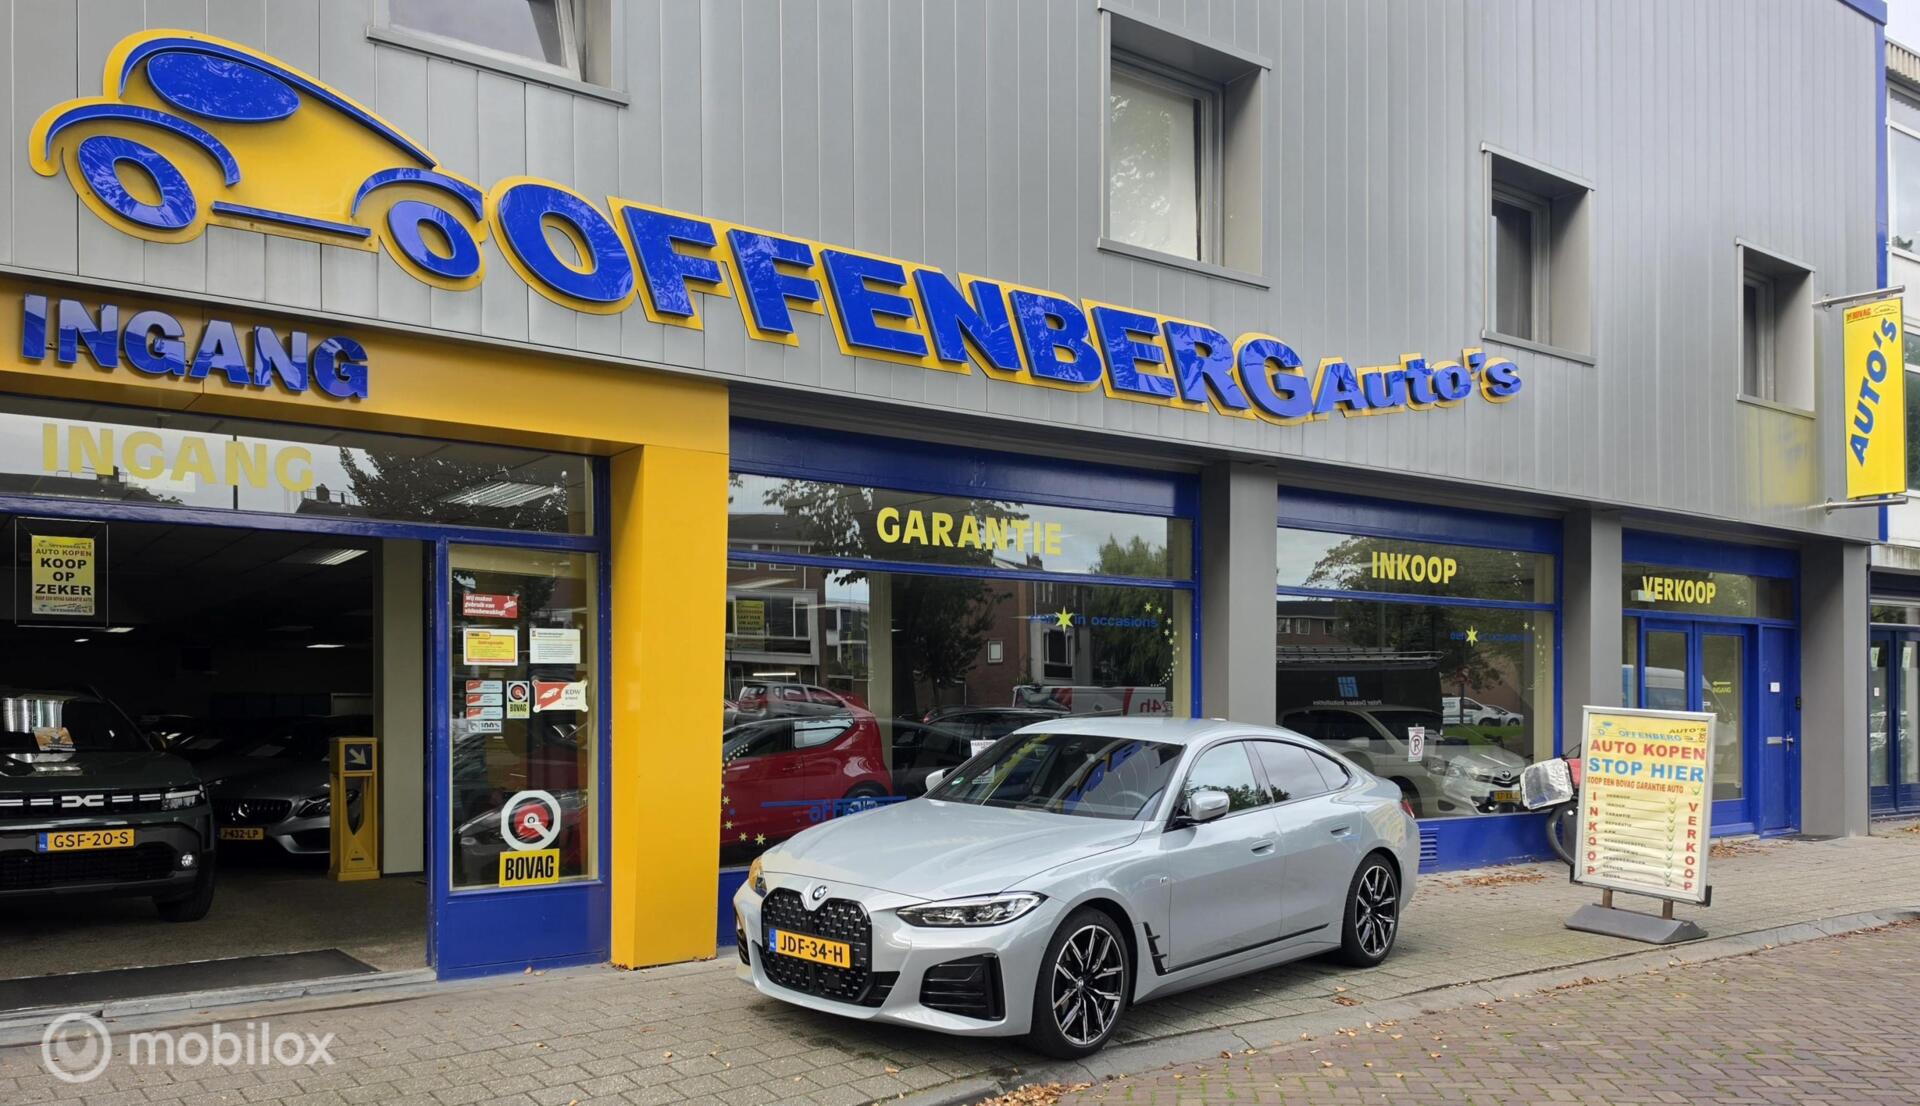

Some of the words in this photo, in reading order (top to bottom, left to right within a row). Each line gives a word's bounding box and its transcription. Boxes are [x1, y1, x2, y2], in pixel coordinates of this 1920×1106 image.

[500, 183, 1313, 418] OFFENBERG
[1315, 351, 1522, 414] Auto's
[21, 293, 368, 399] INGANG
[1850, 317, 1898, 467] AUTO'S
[42, 423, 314, 492] INGANG
[876, 507, 1062, 556] GARANTIE
[35, 548, 60, 556] AUTO
[62, 549, 92, 557] KOPEN
[40, 557, 87, 569] KOOP
[53, 571, 75, 582] OP
[1372, 551, 1457, 584] INKOOP
[35, 583, 92, 596] ZEKER
[1642, 576, 1716, 604] VERKOOP
[1090, 615, 1159, 628] occasions
[509, 703, 527, 713] BOVAG
[1590, 739, 1637, 755] AUTO
[1643, 743, 1706, 760] KOPEN
[1588, 757, 1643, 776] STOP
[1650, 763, 1705, 783] HIER
[1603, 778, 1616, 786] EEN
[1616, 779, 1635, 789] BOVAG
[1636, 781, 1666, 793] GARANTIE
[1666, 783, 1684, 794] AUTO
[53, 831, 129, 848] GSF-20-S
[505, 855, 555, 881] BOVAG
[780, 934, 843, 964] JDF-34-H
